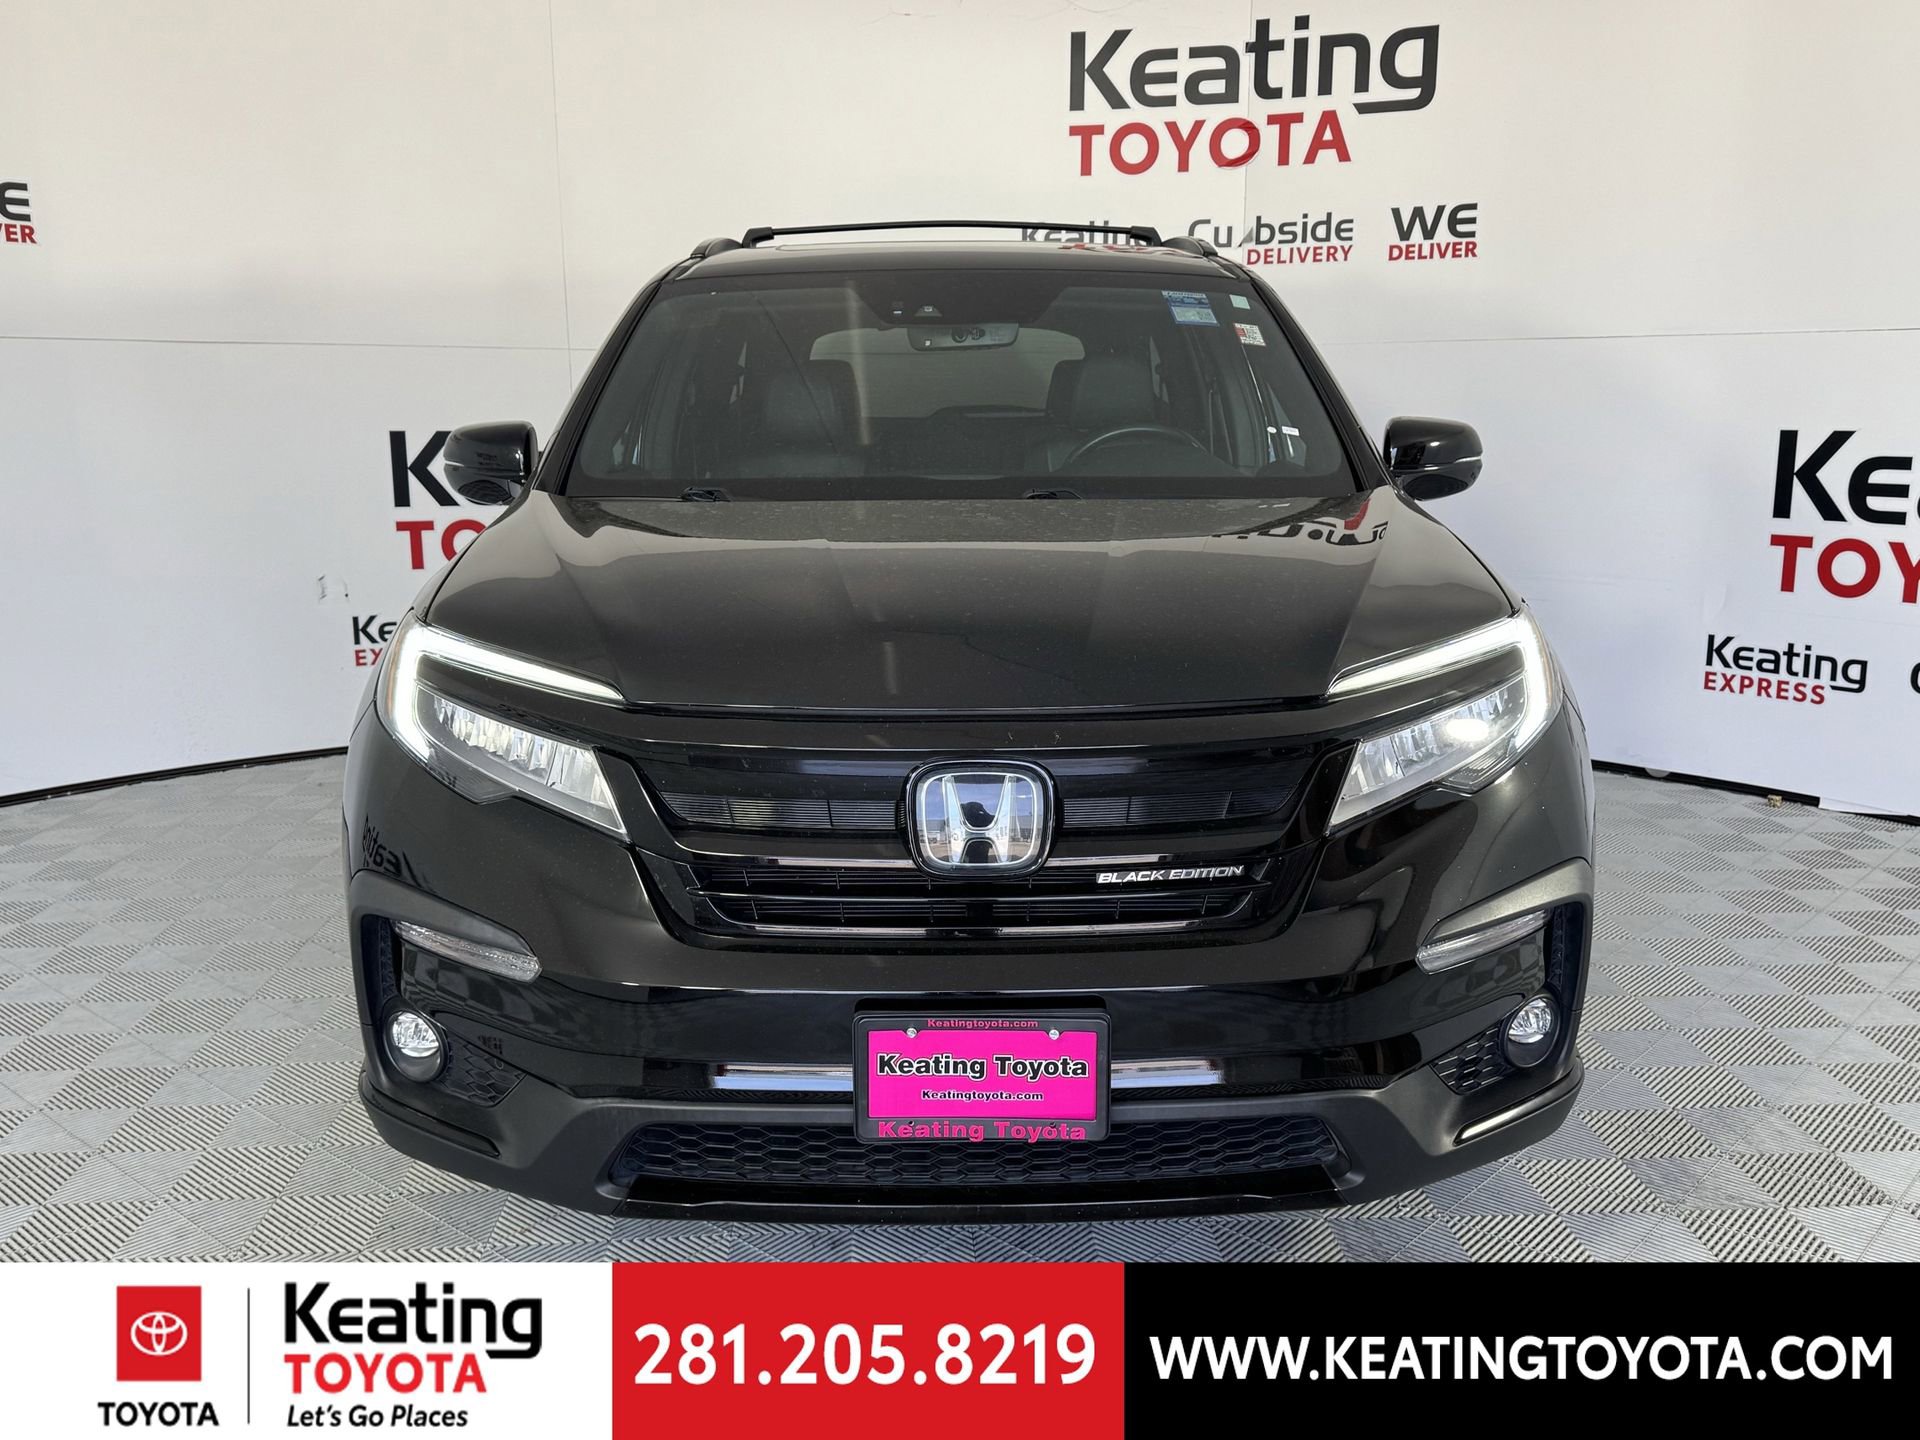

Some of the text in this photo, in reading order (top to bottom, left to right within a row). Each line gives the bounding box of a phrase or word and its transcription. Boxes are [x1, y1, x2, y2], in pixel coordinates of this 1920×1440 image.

[1069, 15, 1440, 115] Keating
[1069, 110, 1351, 177] TOYOTA
[0, 222, 37, 244] ER
[1391, 203, 1478, 241] WE
[1247, 245, 1353, 266] DELIVERY
[1388, 241, 1478, 261] DELIVER
[1772, 429, 1920, 525] Ke
[396, 519, 487, 569] TO
[1770, 534, 1920, 604] TOY
[352, 615, 397, 645] Ke
[1705, 634, 1868, 693] Keating
[1703, 671, 1826, 705] EXPRESS
[1097, 864, 1245, 884] BLACK EDITION
[927, 1018, 1039, 1029] Keatingtoyota.com
[877, 1053, 1089, 1082] Keating Toyota
[921, 1089, 1044, 1102] Keatingtoyota.com
[878, 1120, 1087, 1143] Keating Toyota
